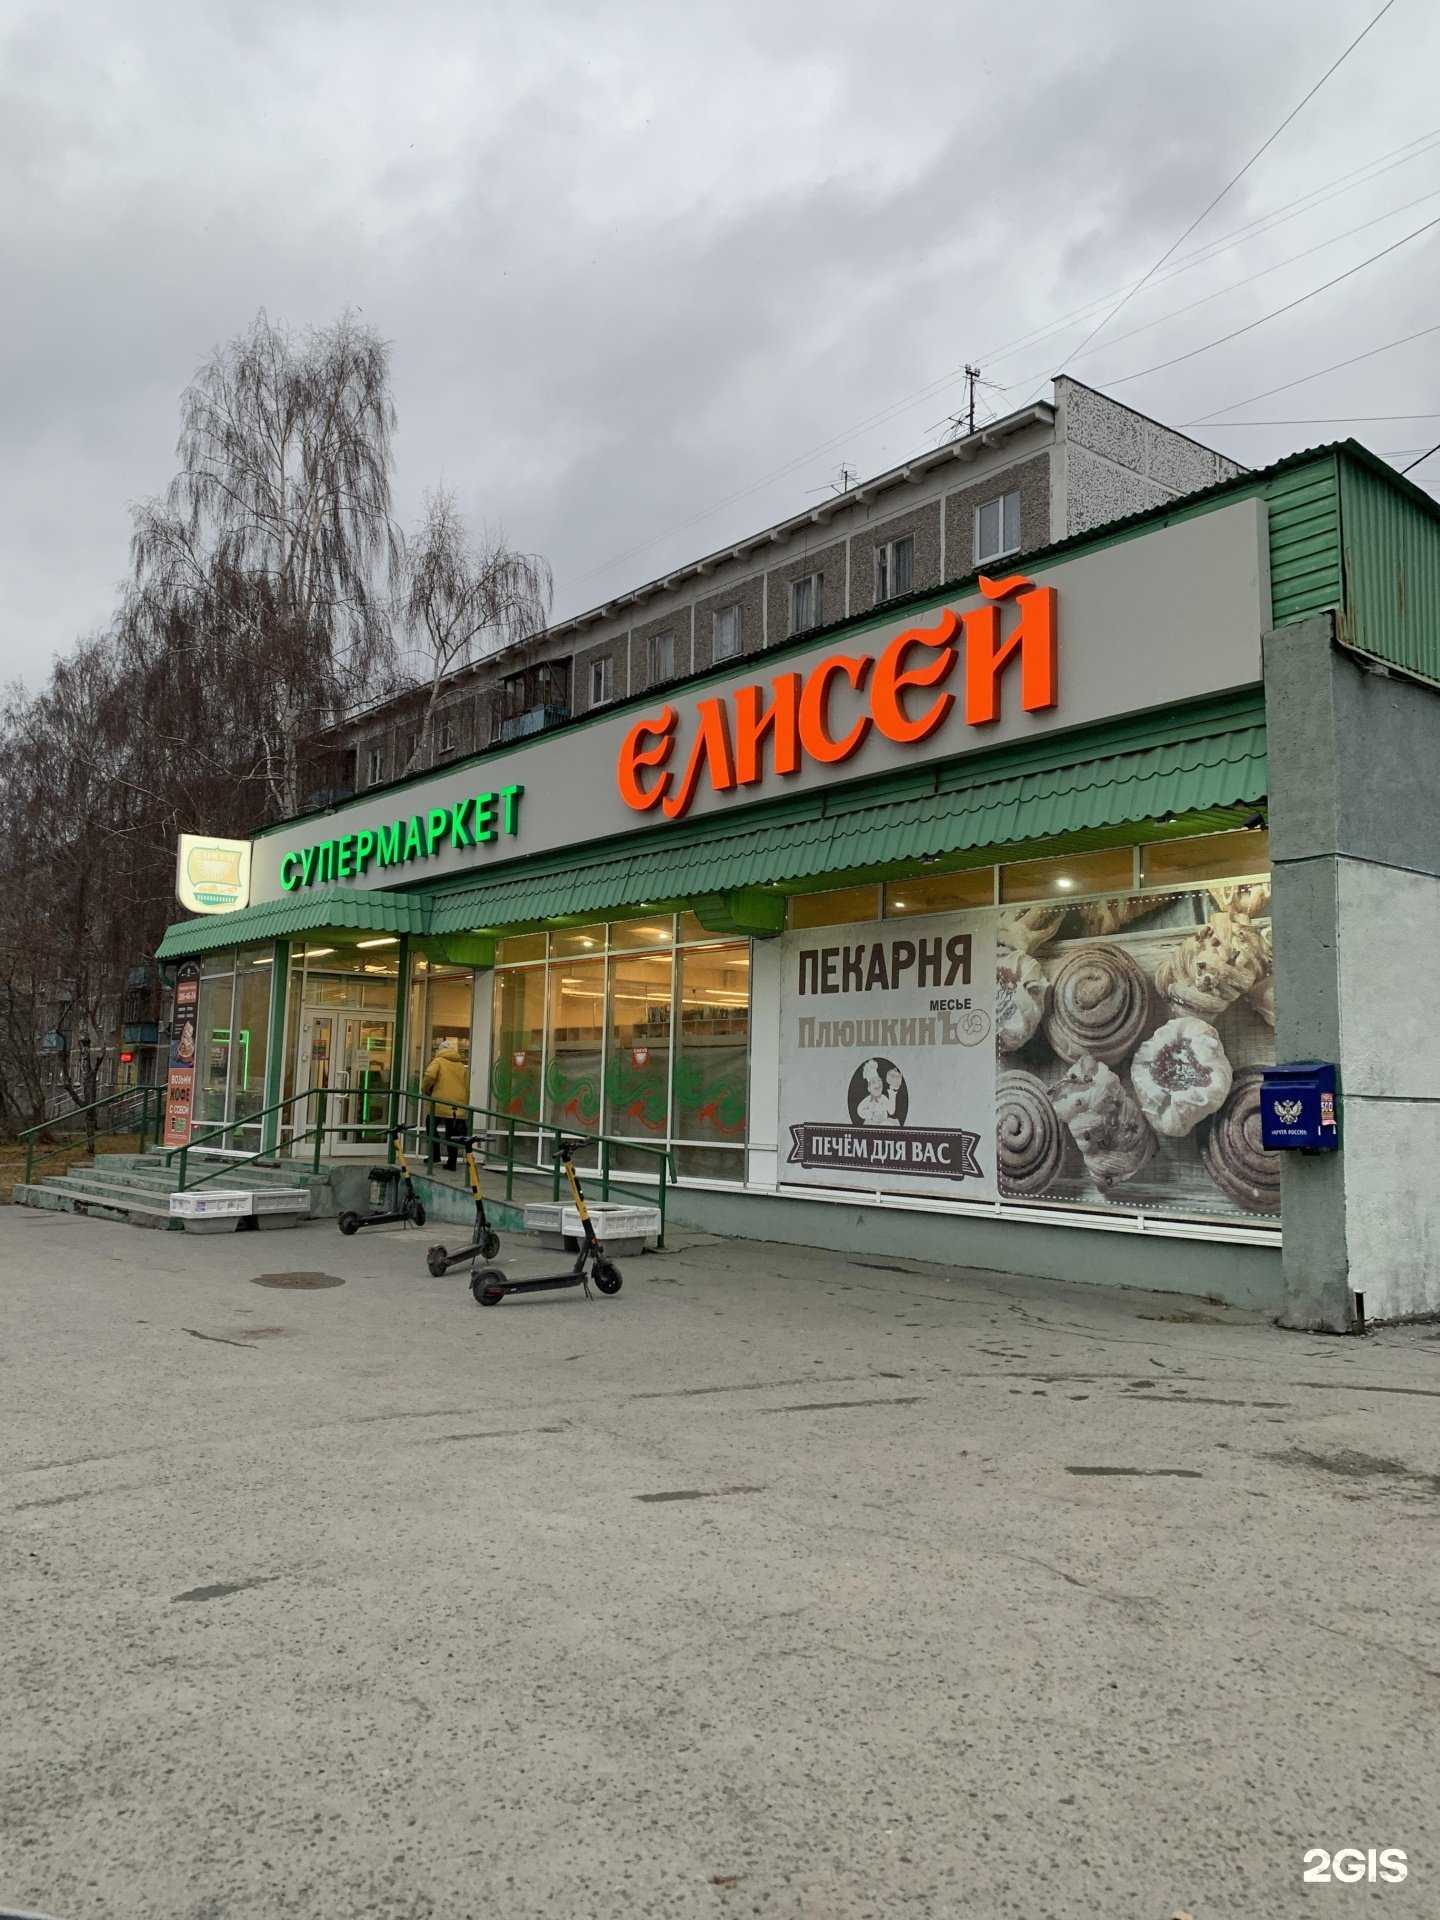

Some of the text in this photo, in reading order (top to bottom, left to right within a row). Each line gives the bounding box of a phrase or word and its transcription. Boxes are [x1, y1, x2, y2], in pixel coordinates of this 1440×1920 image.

[618, 575, 1058, 819] ЕЛИСЕЙ
[280, 785, 525, 891] СУПЕРМАРКЕТ
[798, 934, 972, 995] ПЕКАРНЯ
[930, 998, 972, 1012] МЕСЬЕ
[170, 1087, 190, 1102] КОФЕ
[811, 1135, 952, 1164] ПЕЧЁМ ДЛЯ ВАС
